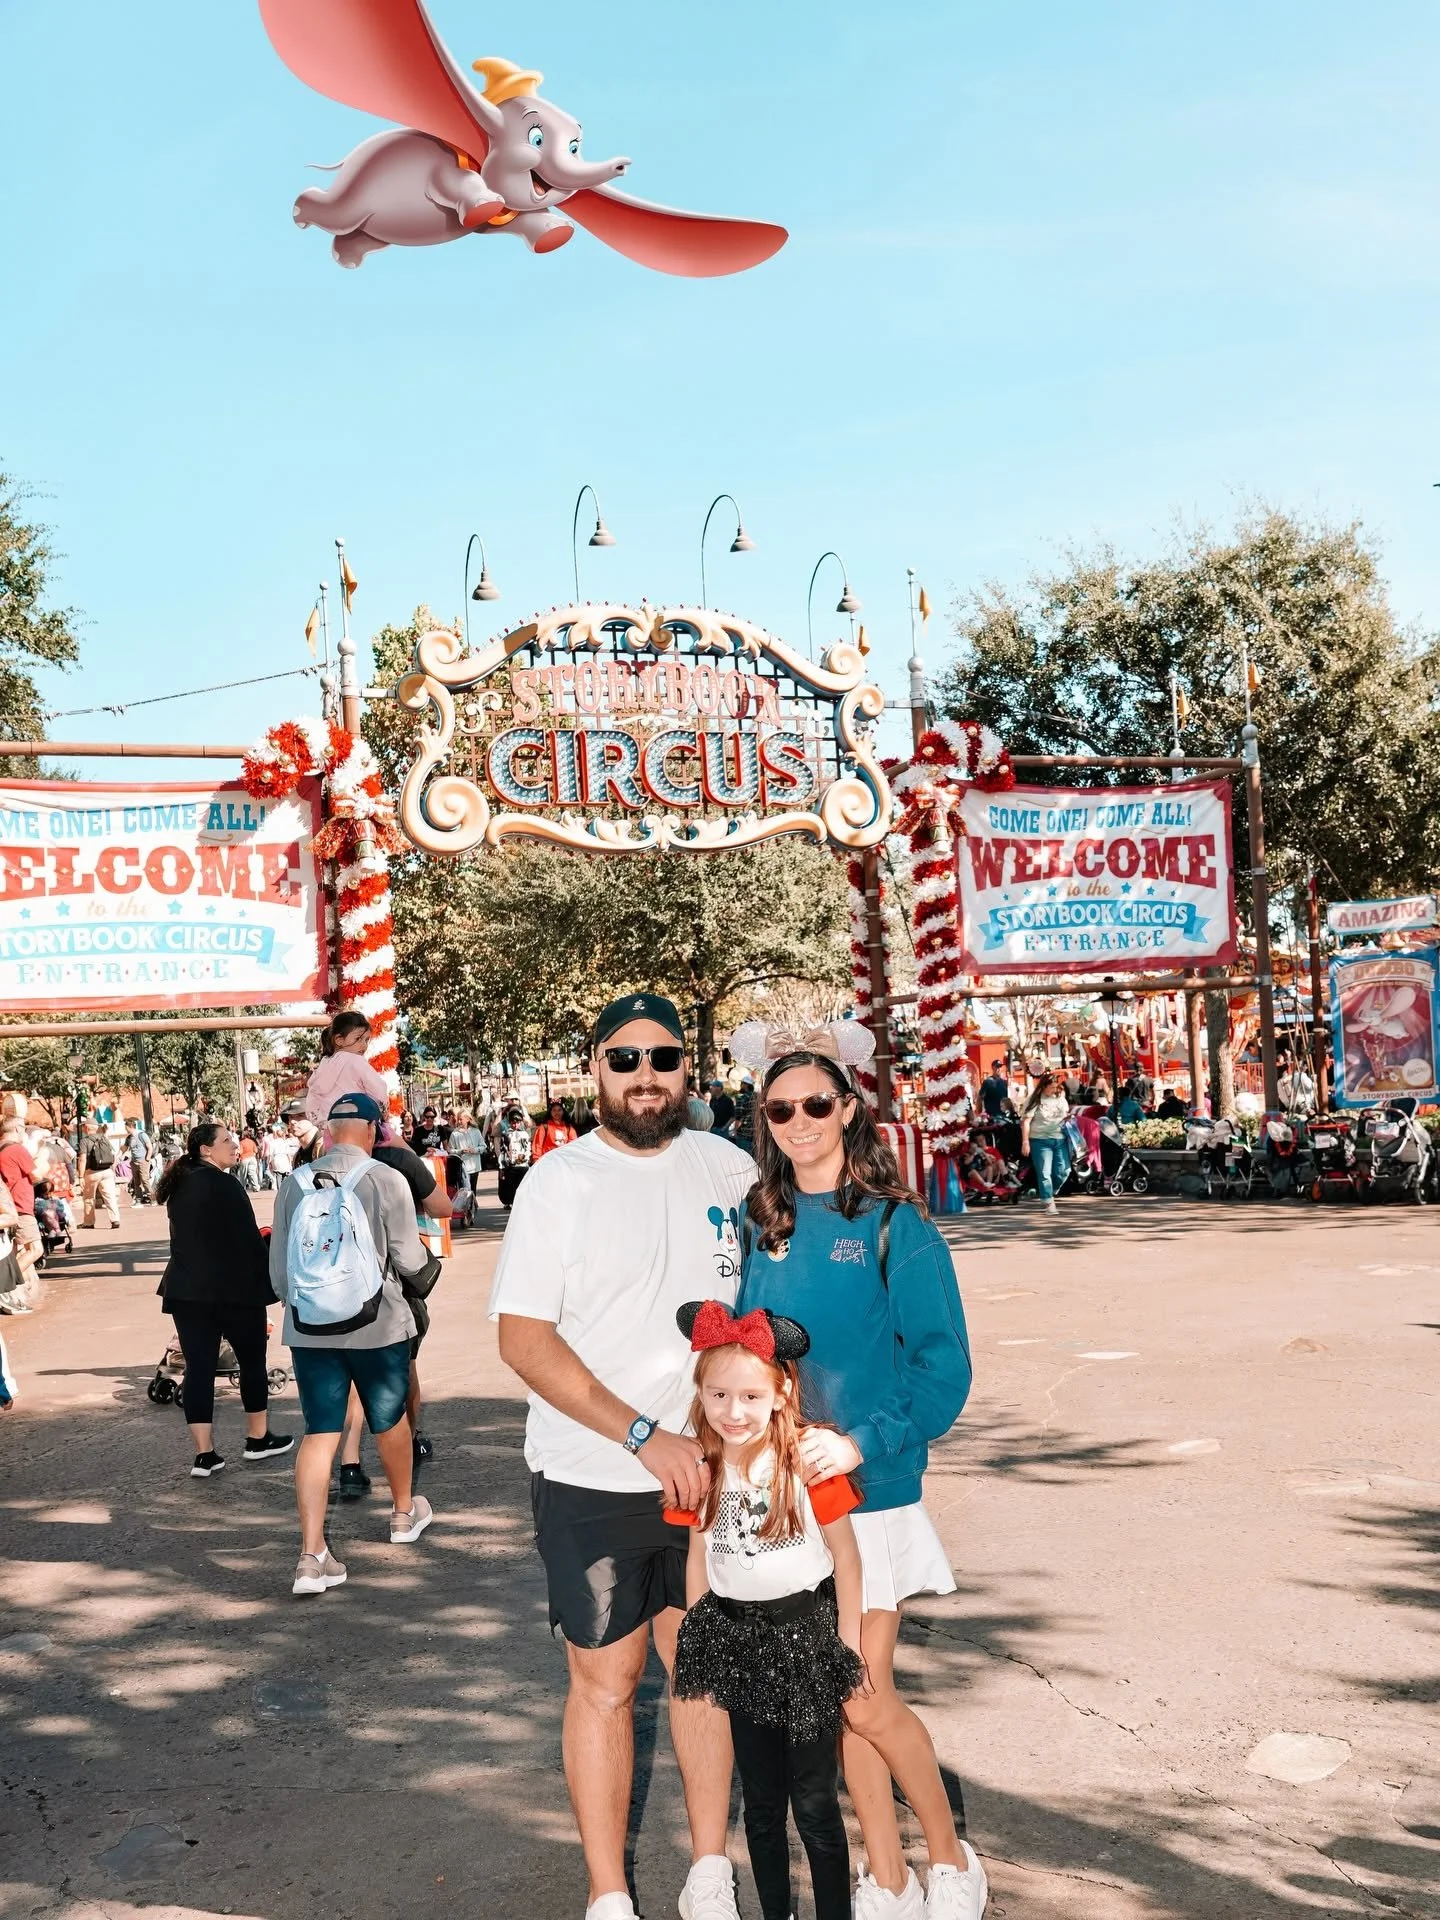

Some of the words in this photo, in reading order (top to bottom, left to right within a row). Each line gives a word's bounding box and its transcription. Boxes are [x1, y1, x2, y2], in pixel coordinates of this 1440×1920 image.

[512, 660, 783, 728] STORYBOOK
[487, 726, 816, 809] CIRCUS
[49, 808, 112, 838] ONE!
[123, 804, 197, 833] COME
[206, 803, 265, 831] ALL!
[989, 805, 1041, 834] COME
[1047, 807, 1088, 832] ONE!
[1095, 804, 1145, 829] COME
[1151, 802, 1192, 826] ALL!
[966, 834, 1217, 892] WELCOME
[1067, 883, 1082, 897] to
[1086, 879, 1112, 897] the
[87, 901, 107, 917] to
[116, 895, 152, 917] the
[997, 903, 1115, 930] STORYBOOK
[1119, 903, 1188, 925] CIRCUS
[1337, 902, 1427, 928] AMAZING
[165, 926, 263, 953] CIRCUS
